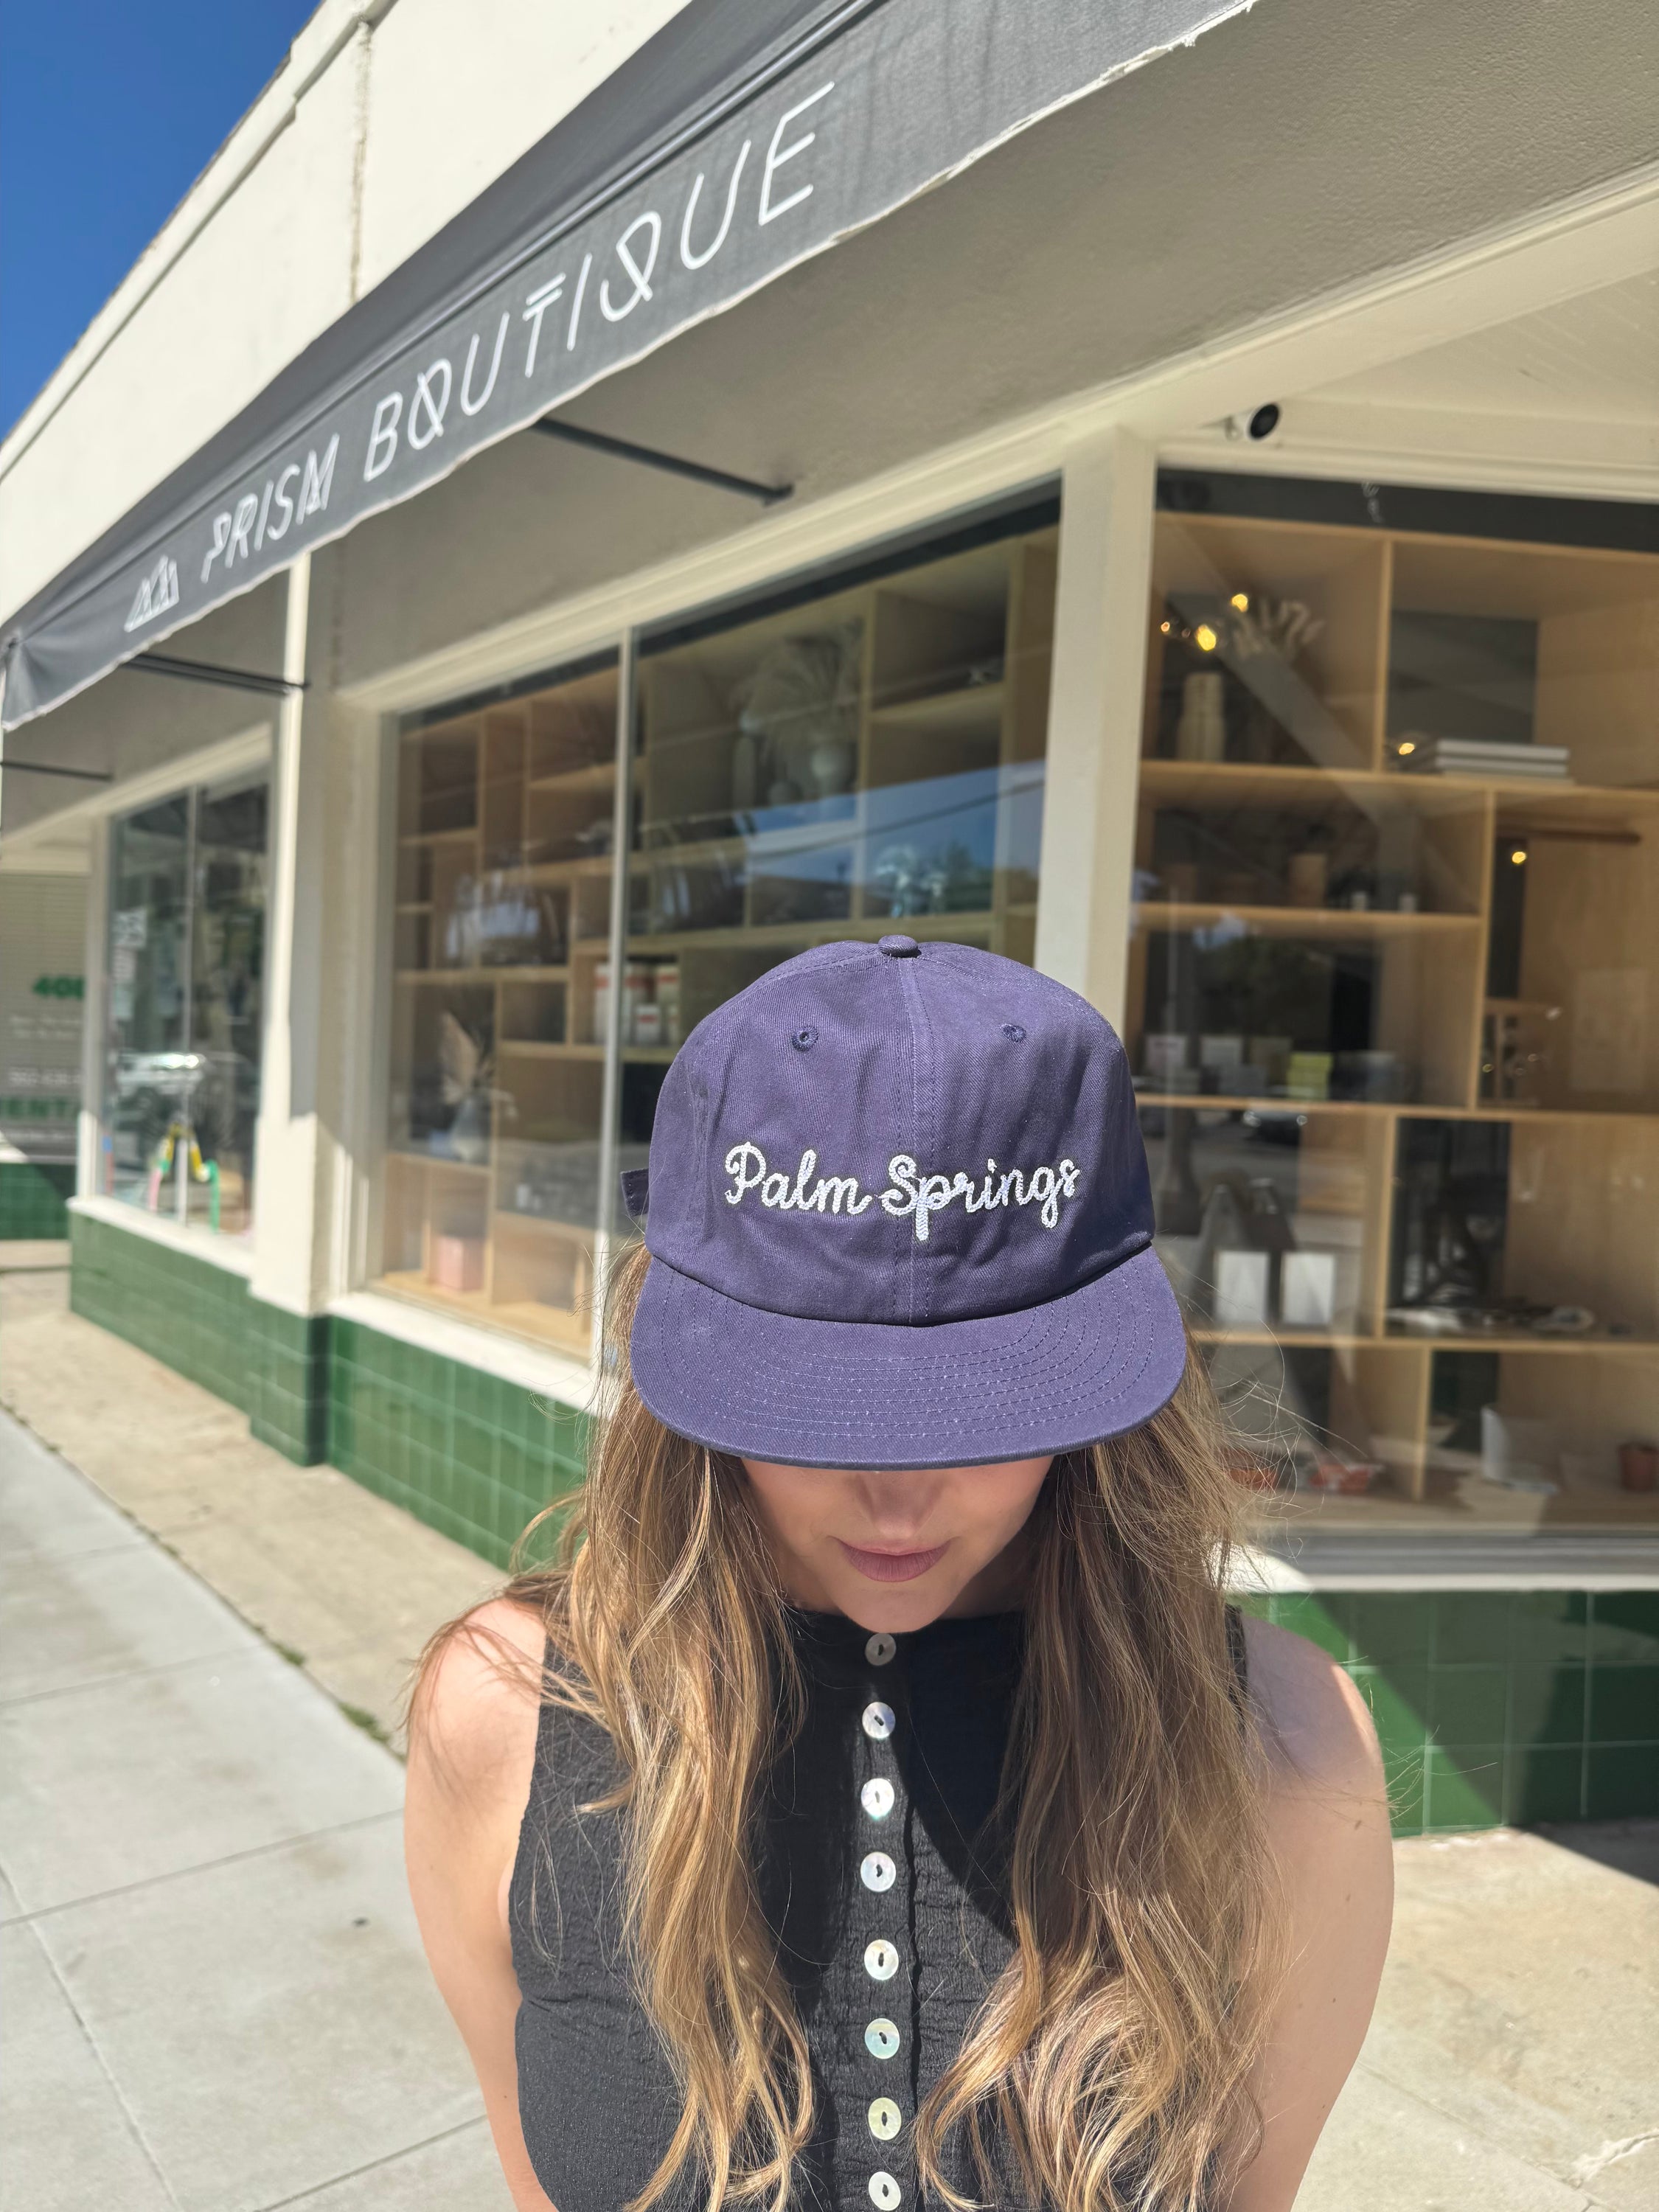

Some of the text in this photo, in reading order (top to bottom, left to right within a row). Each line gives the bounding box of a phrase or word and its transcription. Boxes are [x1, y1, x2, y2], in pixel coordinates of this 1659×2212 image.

[200, 80, 835, 584] PRISM BOUTIQUE
[724, 1141, 1081, 1242] Palm Springs
